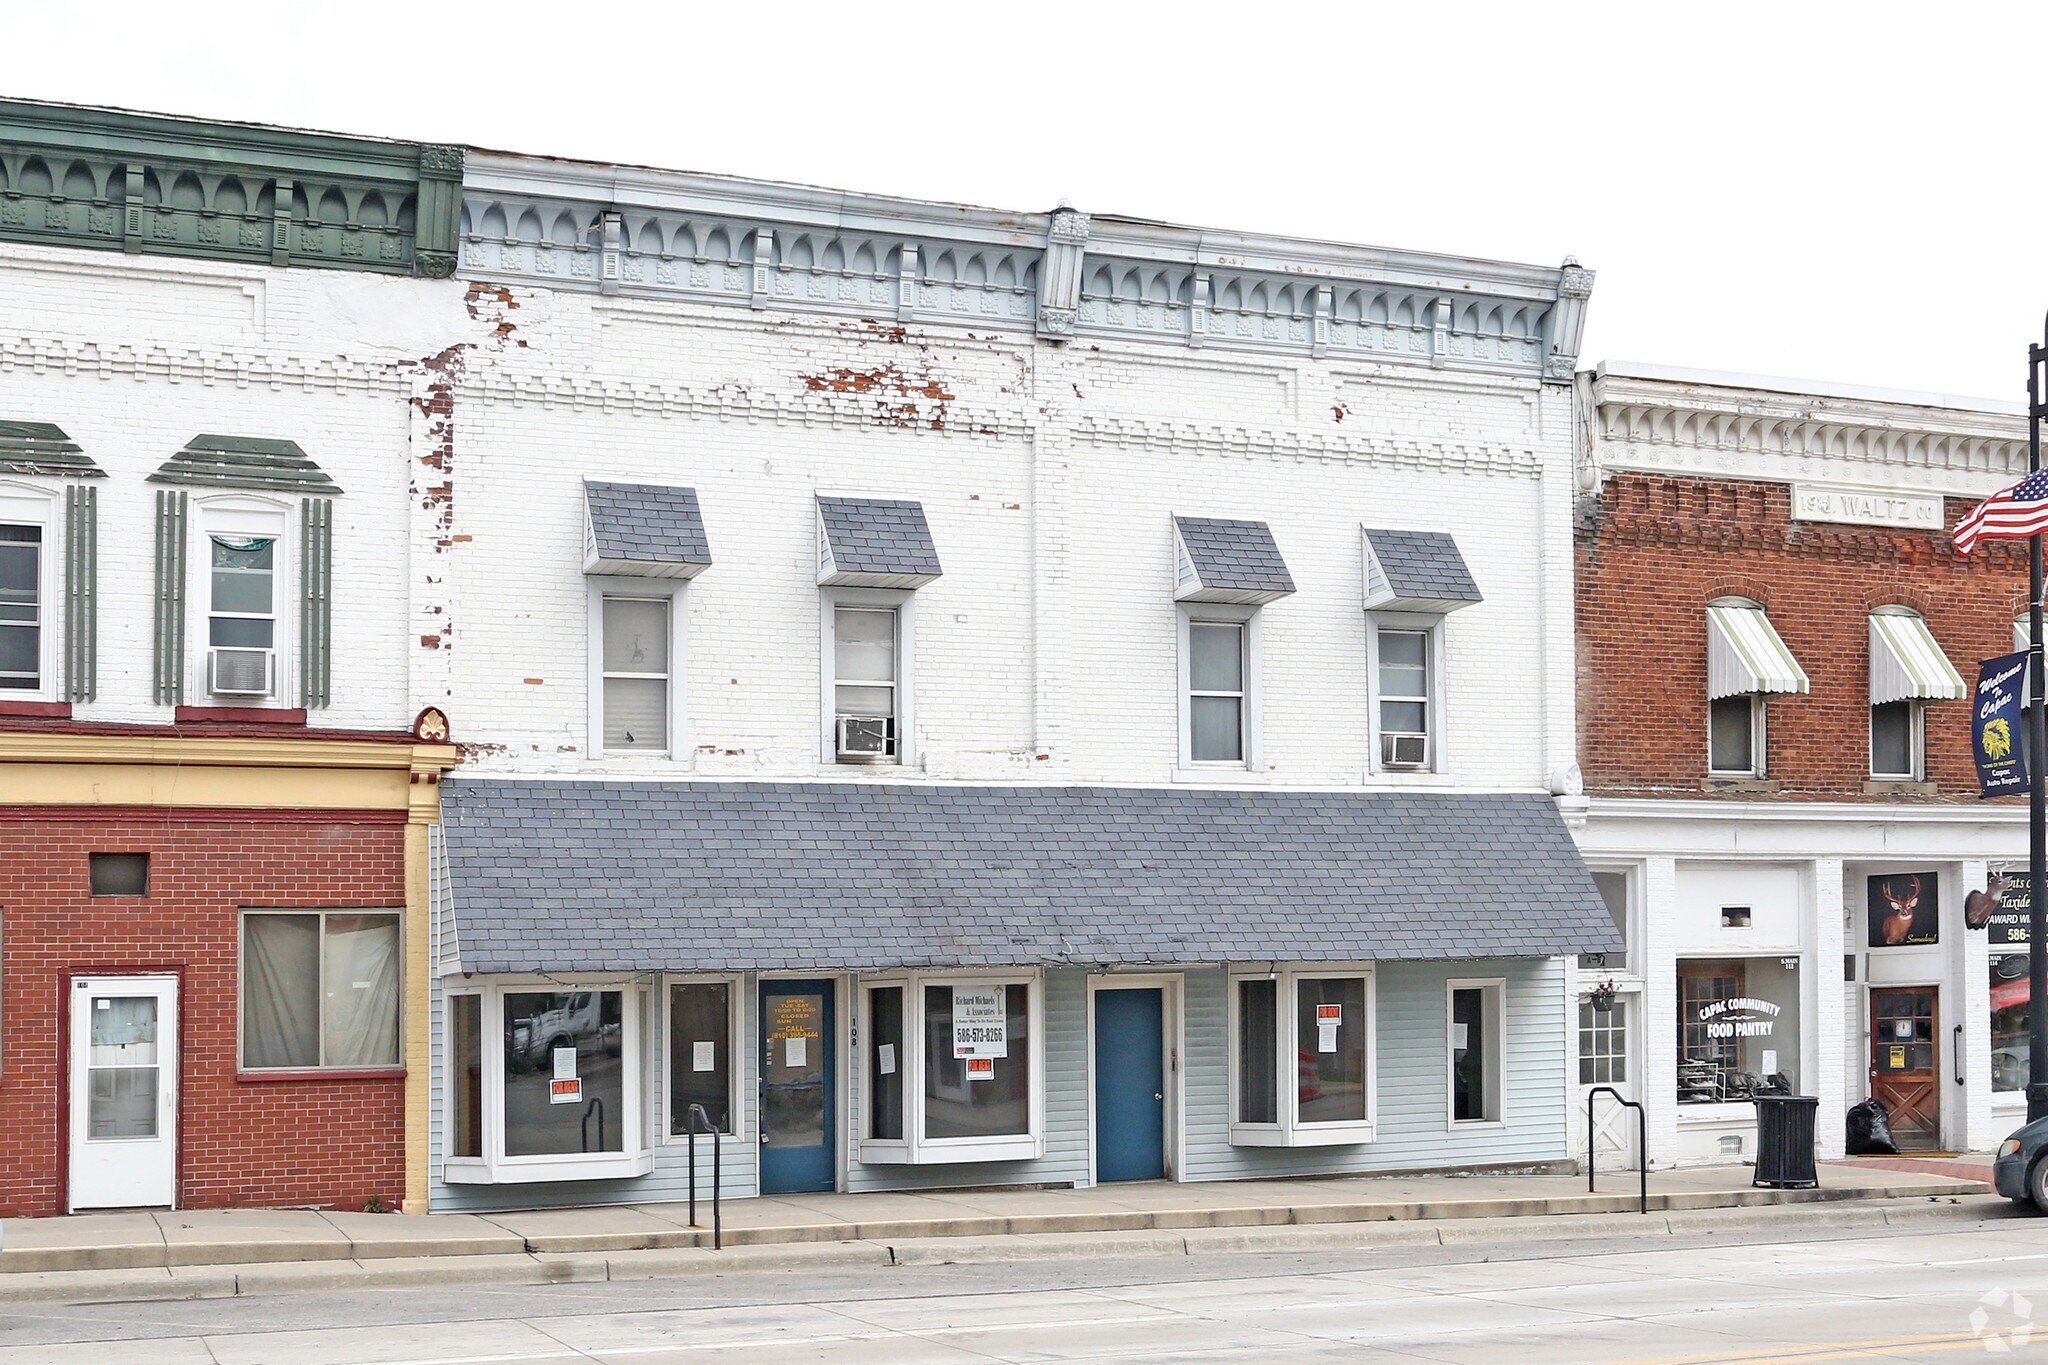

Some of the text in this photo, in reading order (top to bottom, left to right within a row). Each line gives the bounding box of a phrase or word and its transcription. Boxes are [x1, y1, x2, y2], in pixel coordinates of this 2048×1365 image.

[1840, 496, 1909, 520] WALTZ
[1979, 662, 2022, 694] Welcome
[1991, 686, 2003, 699] To
[1979, 692, 2013, 719] Capac
[1991, 769, 2010, 778] Capac
[2000, 894, 2030, 910] Taxide
[1988, 914, 2018, 924] AWARD
[956, 995, 995, 1005] Richard Michaels
[1699, 998, 1781, 1020] CAPAC COMMUNITY
[957, 1028, 1003, 1043] 586-573-8266
[1707, 1021, 1773, 1038] FOOD PANTRY
[553, 1080, 579, 1094] FOR RENT
